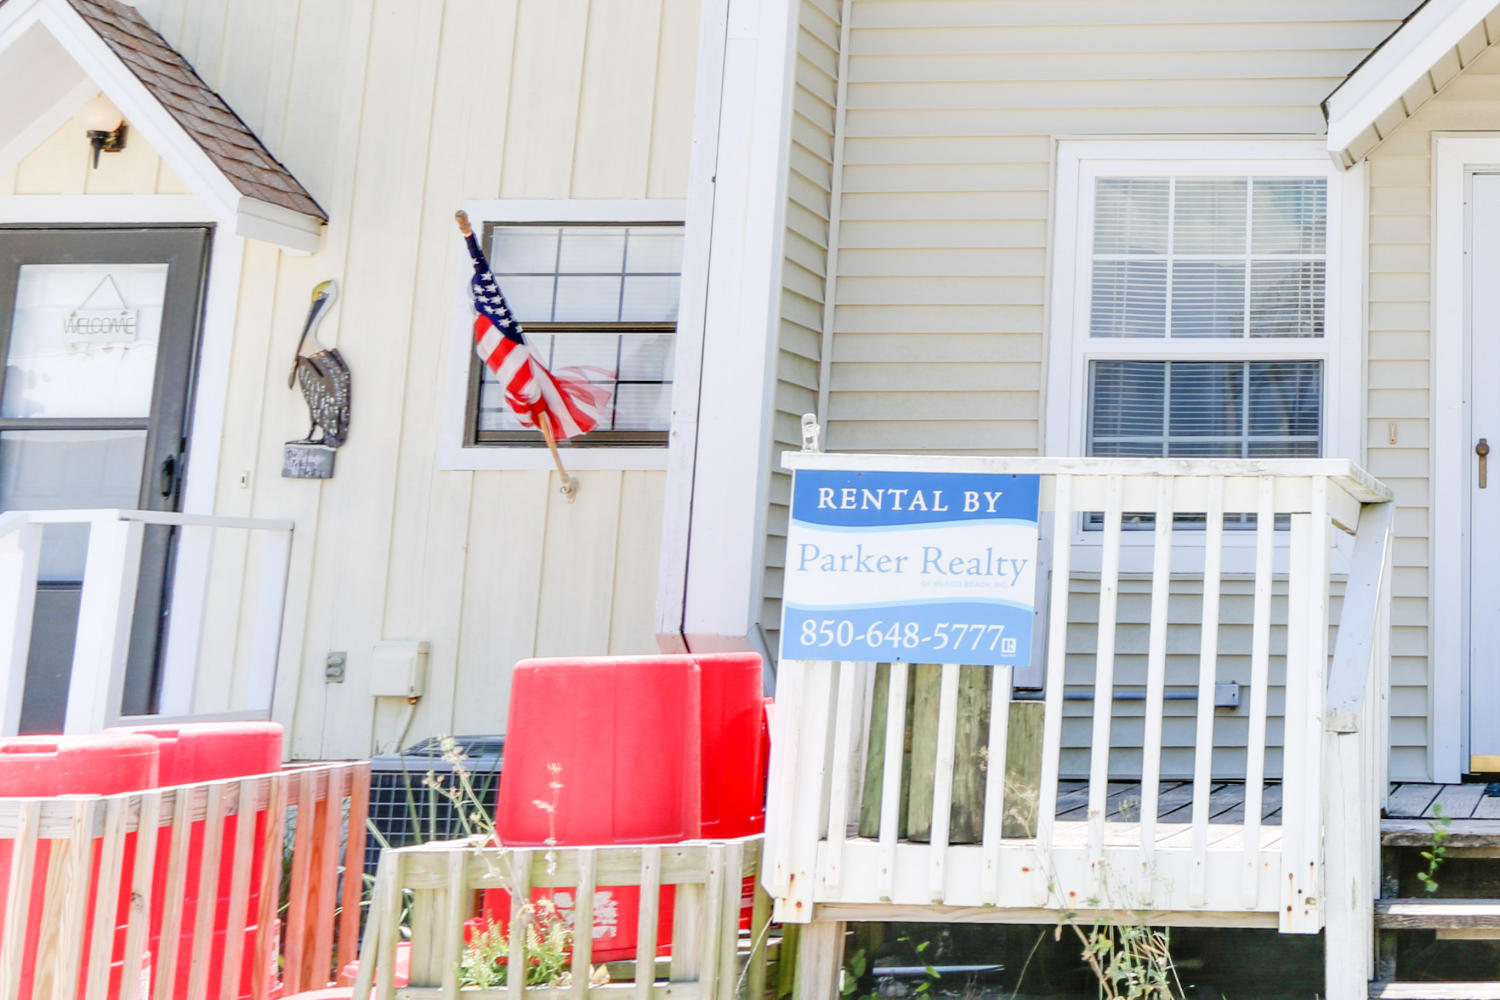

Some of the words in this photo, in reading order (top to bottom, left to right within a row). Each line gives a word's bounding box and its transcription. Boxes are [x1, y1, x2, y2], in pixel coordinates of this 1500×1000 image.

[64, 317, 135, 335] WELCOME
[817, 487, 949, 512] RENTAL
[962, 491, 1003, 513] BY
[797, 543, 909, 574] Parker
[920, 546, 1028, 587] Realty
[800, 619, 1005, 651] 850-648-5777
